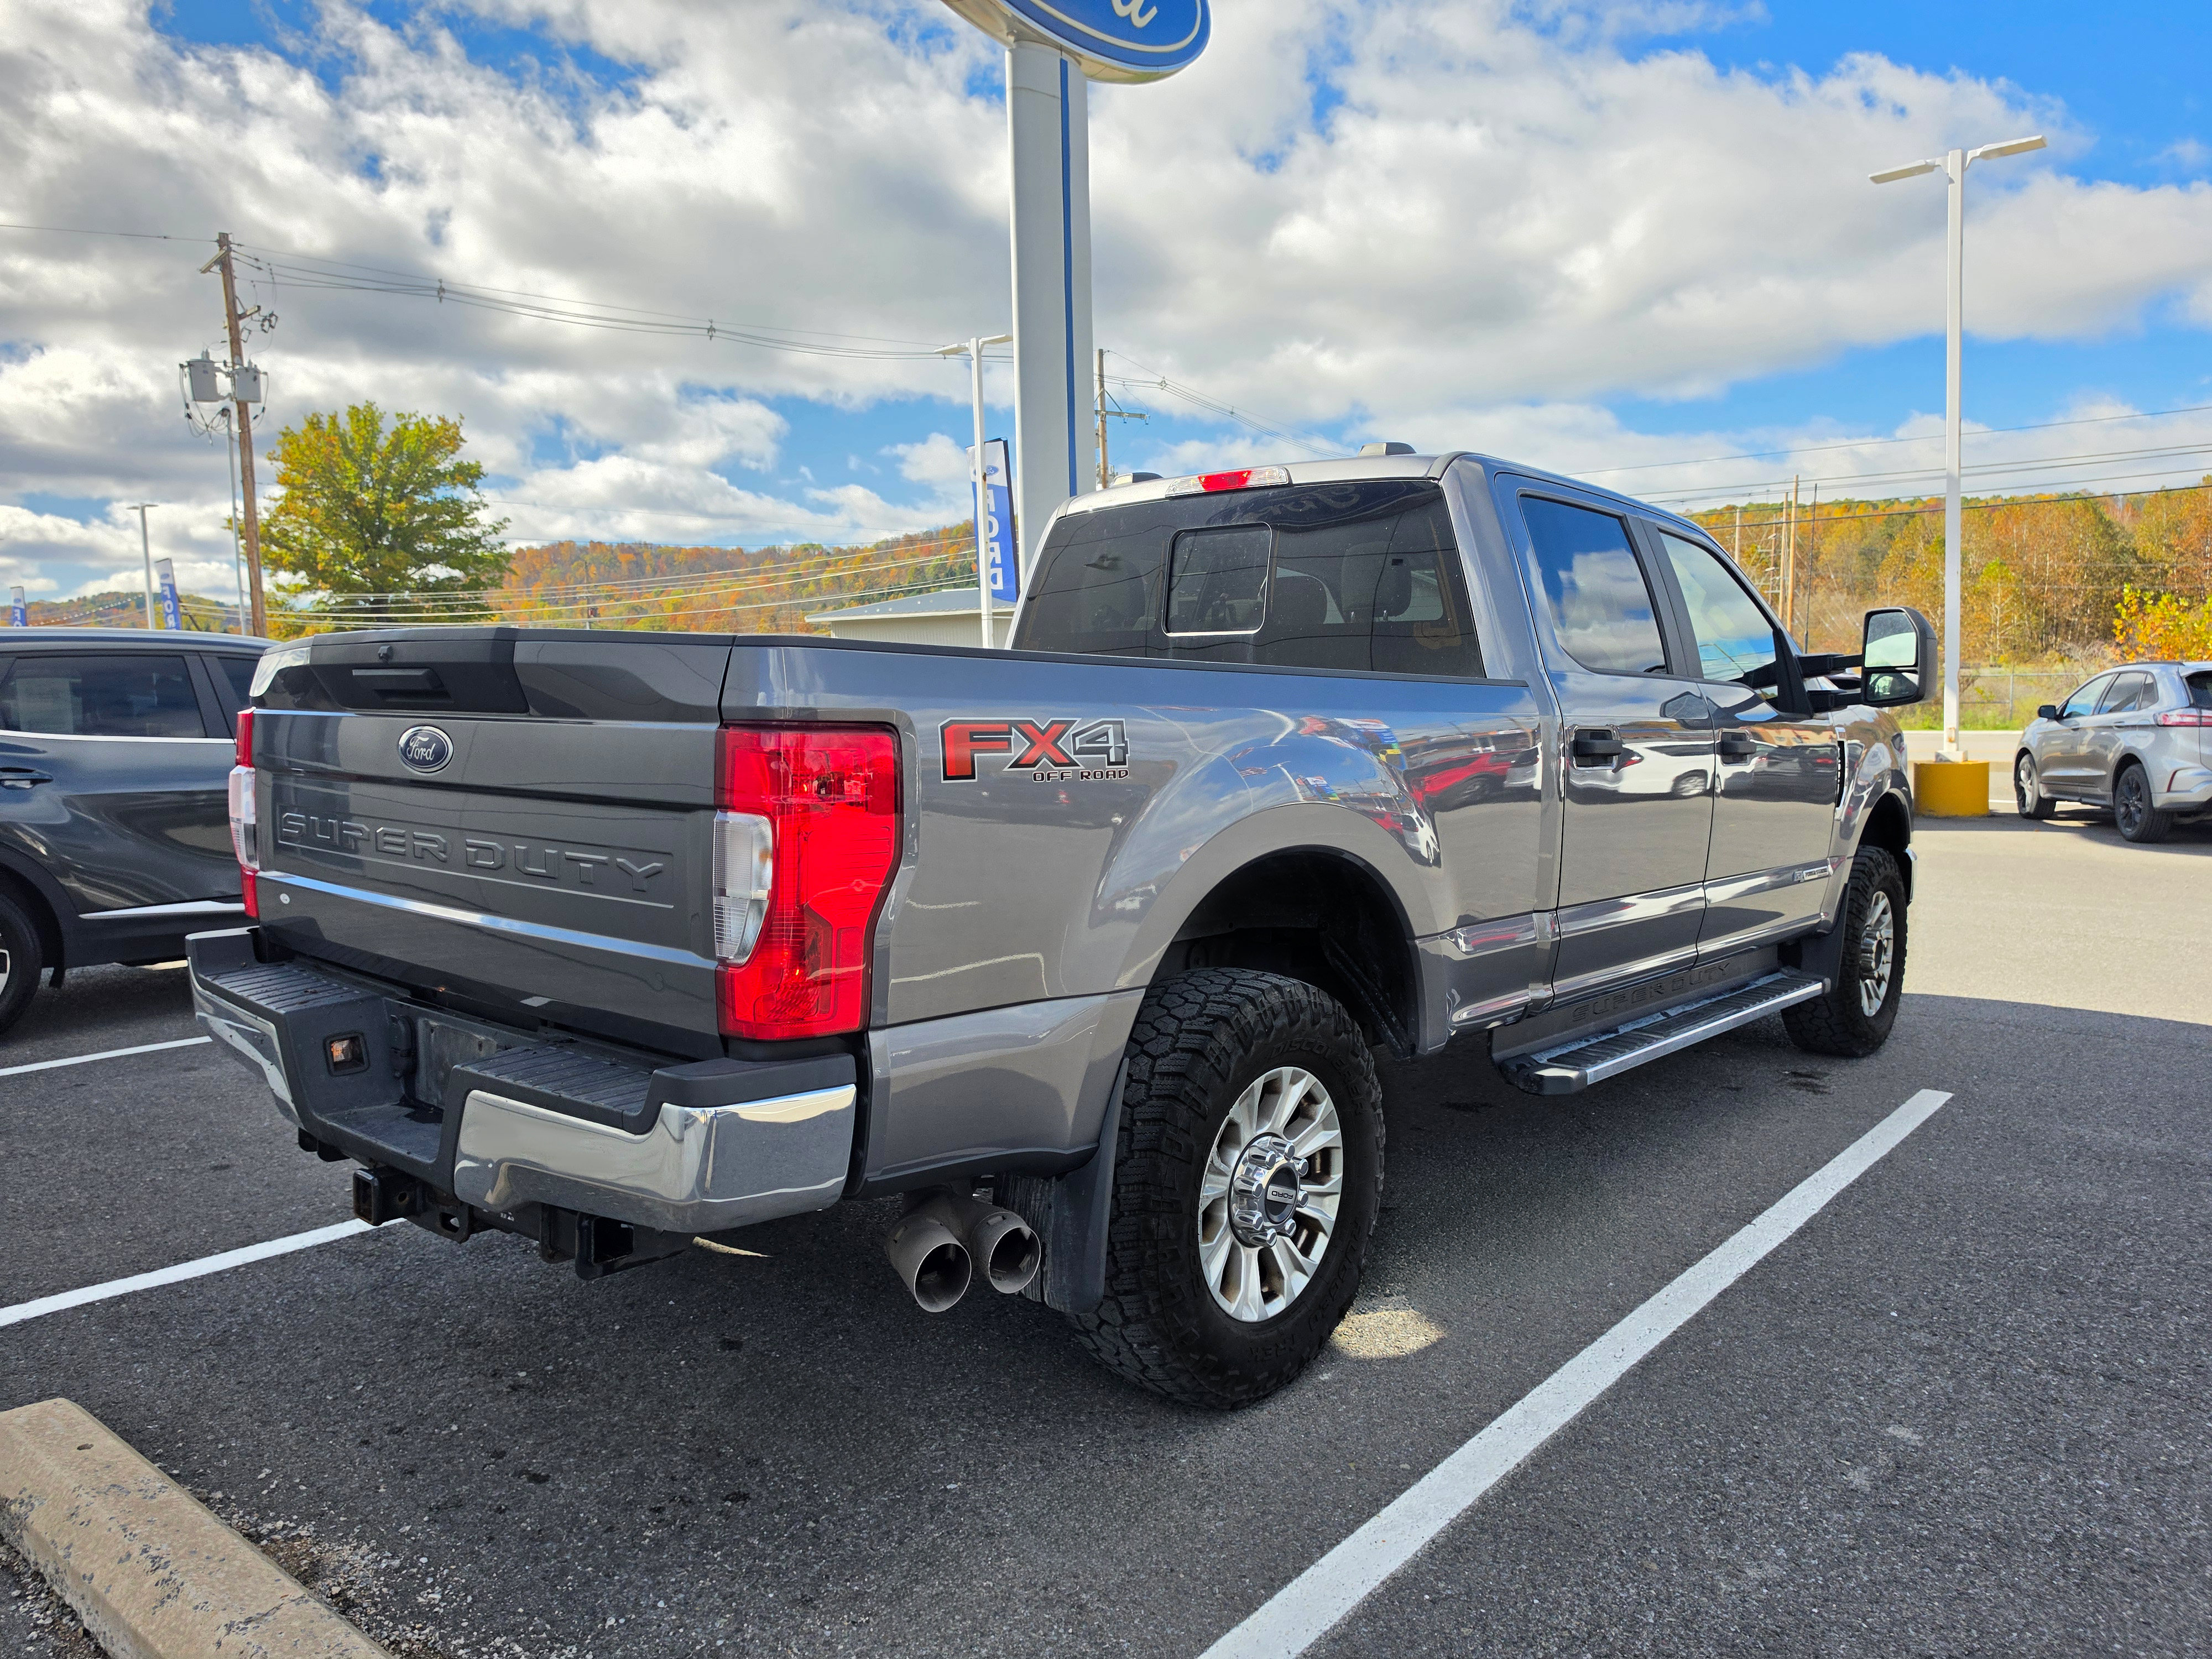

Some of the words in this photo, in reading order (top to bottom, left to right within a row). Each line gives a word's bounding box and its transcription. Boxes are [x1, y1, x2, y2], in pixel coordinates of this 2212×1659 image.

[406, 735, 436, 761] Ford
[938, 717, 1130, 783] FX4
[1032, 770, 1072, 782] OFF
[1079, 769, 1130, 782] ROAD
[281, 811, 448, 863] SUPER
[466, 839, 664, 893] DUTY
[1572, 983, 1665, 1023] SUPER
[1671, 962, 1730, 992] DUTY
[1271, 1190, 1294, 1199] FORD
